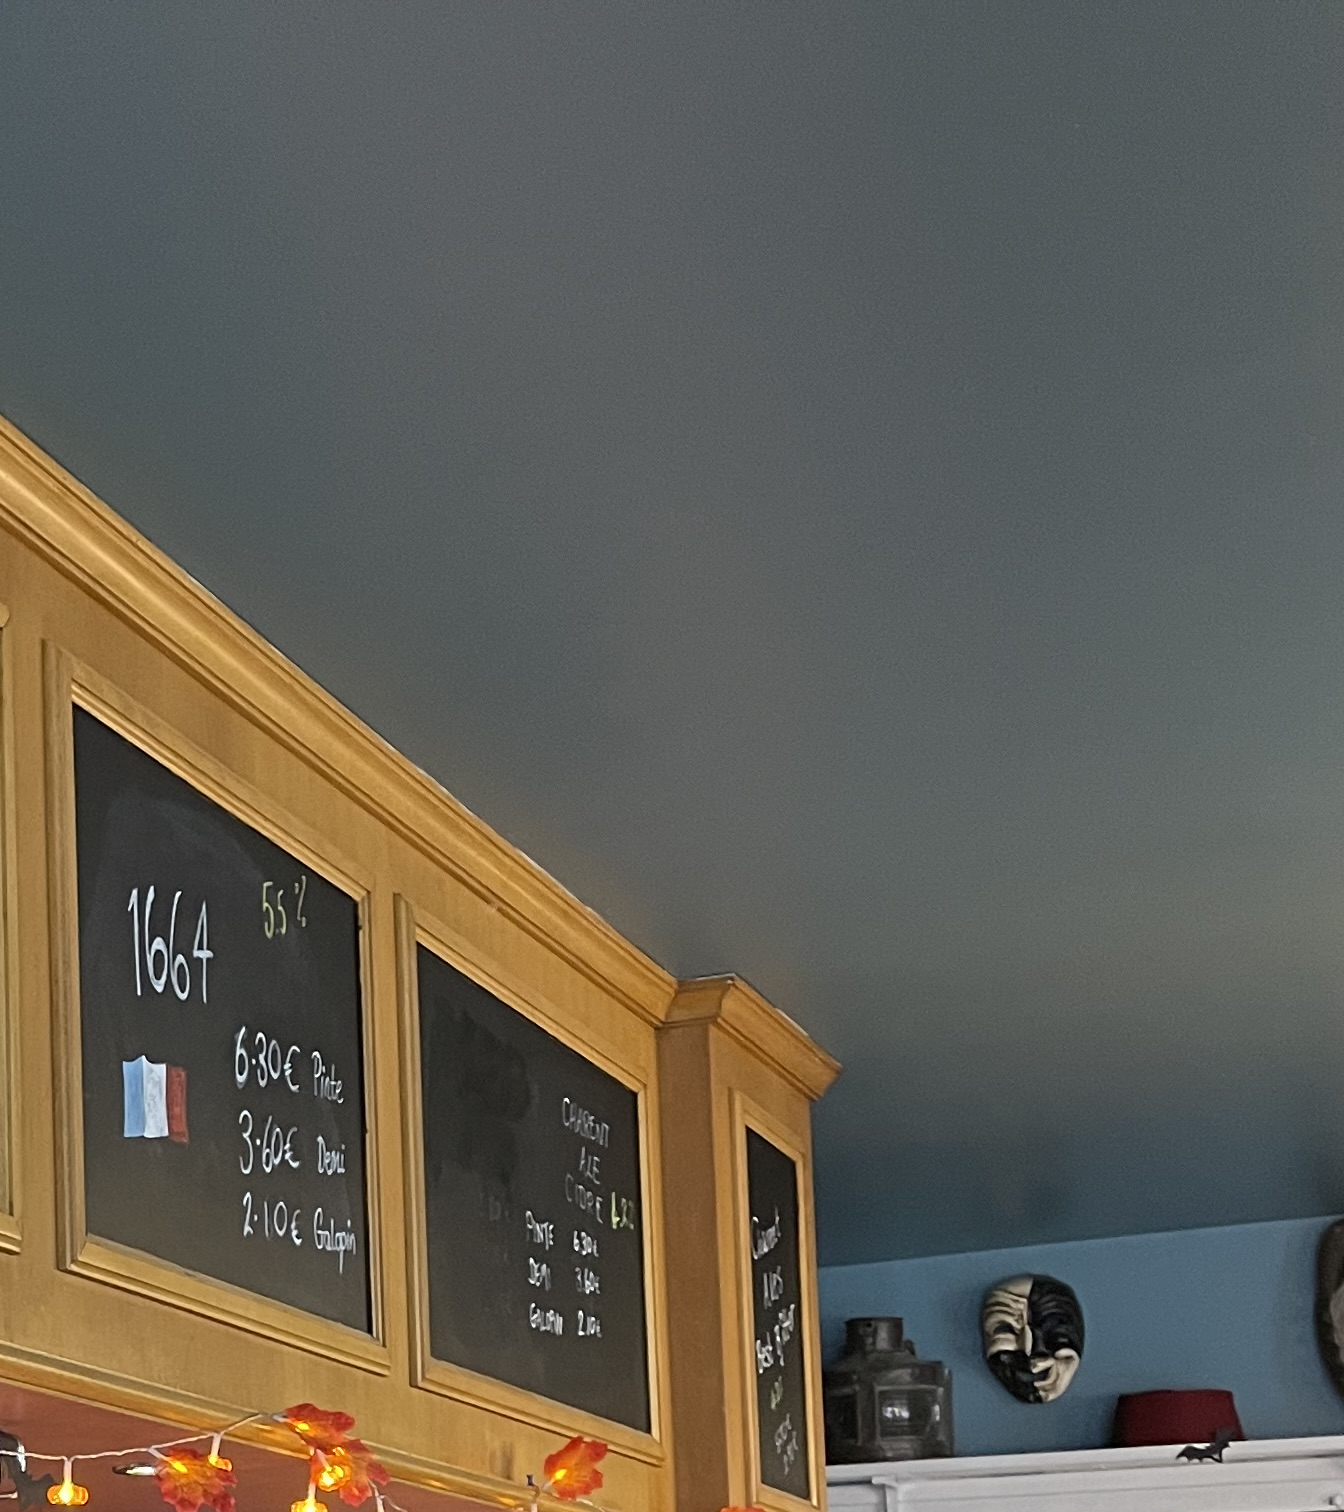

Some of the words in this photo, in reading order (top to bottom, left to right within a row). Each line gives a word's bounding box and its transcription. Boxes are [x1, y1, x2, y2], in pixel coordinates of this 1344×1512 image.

[127, 884, 214, 1004] 1664
[234, 1025, 300, 1093] 6.30€
[312, 1050, 344, 1104] Pinte
[238, 1109, 300, 1175] 3.60€
[316, 1135, 346, 1176] Demi
[242, 1191, 303, 1246] 2.10€
[313, 1207, 357, 1275] Galopin
